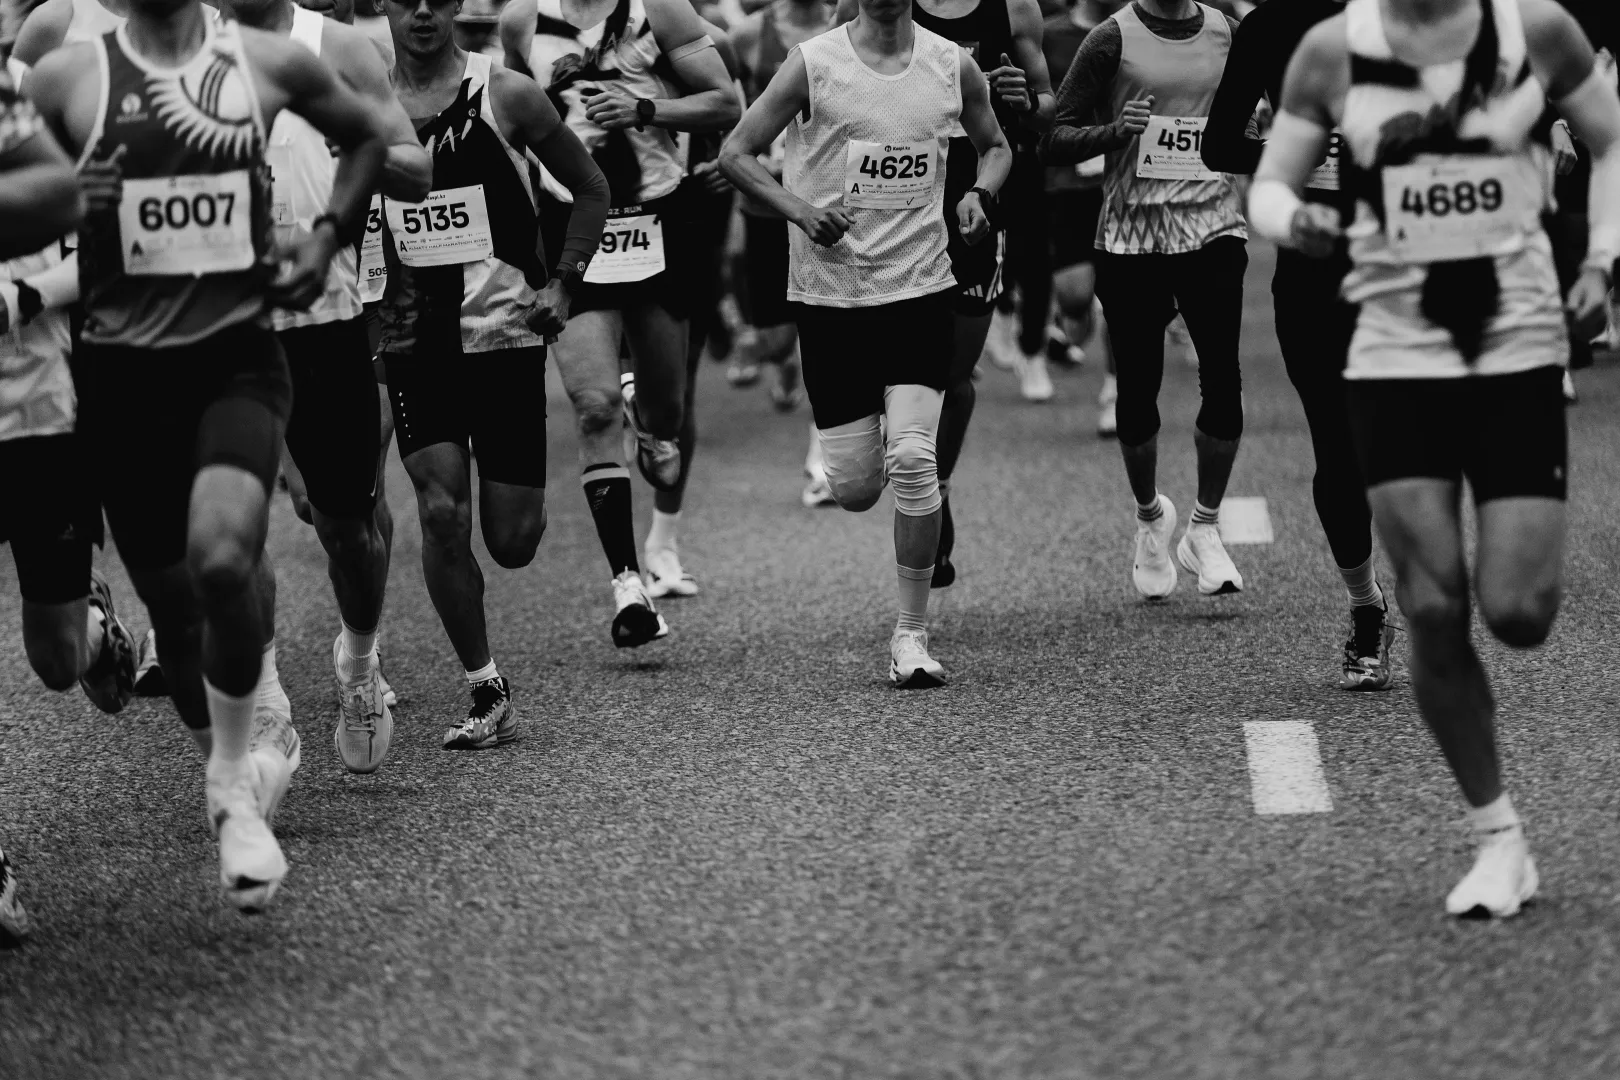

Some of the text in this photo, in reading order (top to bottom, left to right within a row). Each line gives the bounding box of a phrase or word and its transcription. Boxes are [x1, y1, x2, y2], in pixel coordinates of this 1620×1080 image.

[1157, 128, 1203, 152] 451
[859, 153, 929, 180] 4625
[1143, 154, 1153, 166] A
[850, 182, 861, 195] A
[1400, 178, 1504, 218] 4689
[138, 191, 236, 232] 6007
[402, 201, 470, 235] 5135
[400, 240, 408, 253] A
